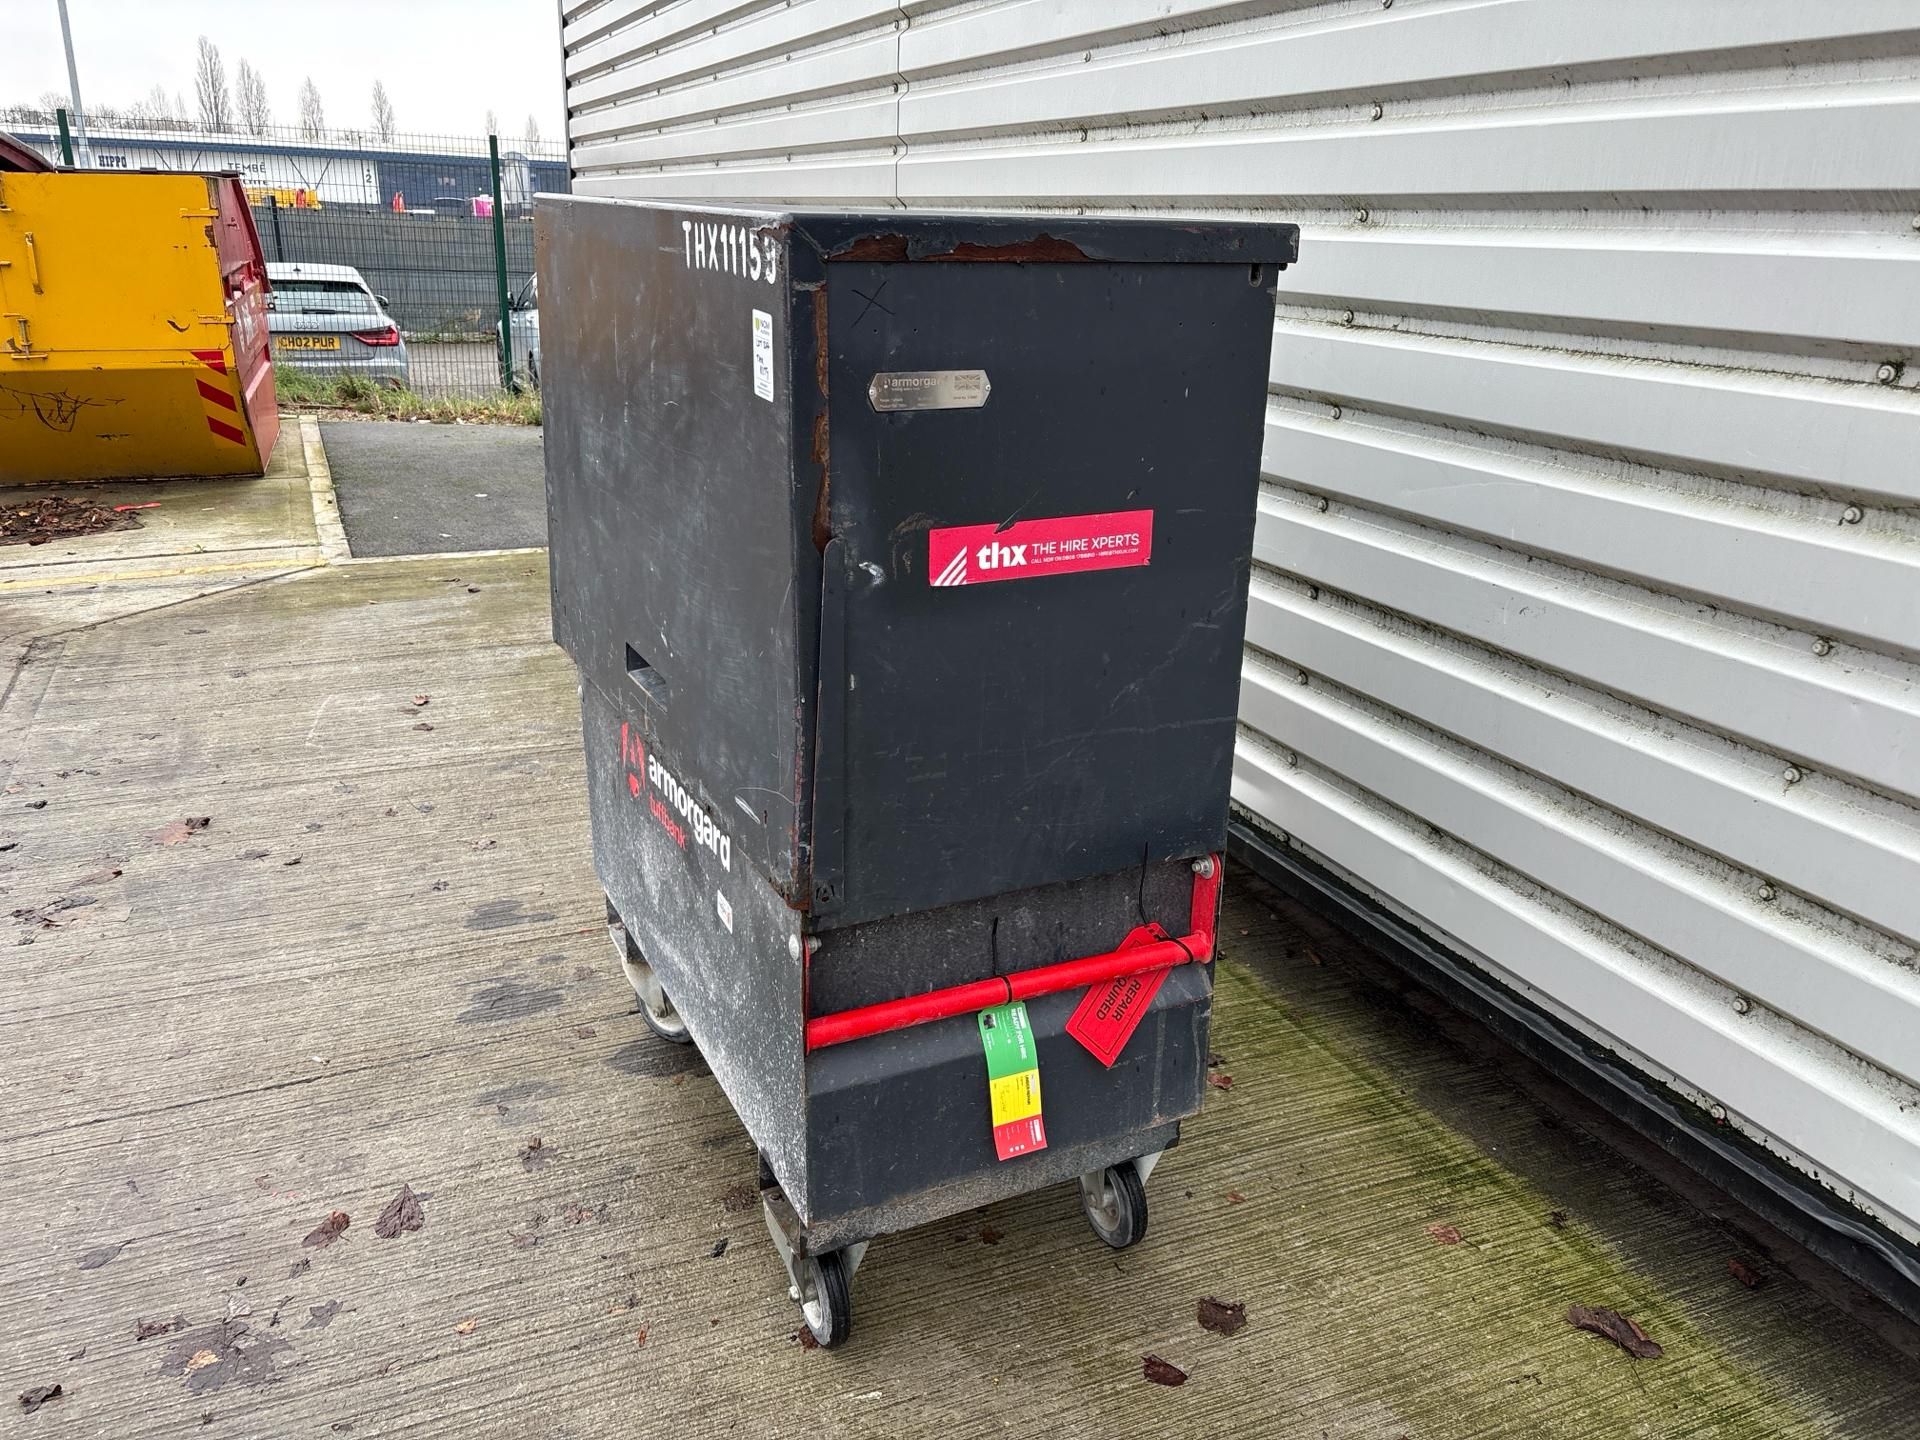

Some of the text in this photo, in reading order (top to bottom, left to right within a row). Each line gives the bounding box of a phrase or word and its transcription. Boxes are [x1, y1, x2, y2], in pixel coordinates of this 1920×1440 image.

[98, 155, 127, 168] HIPPO
[312, 337, 335, 348] PUR
[976, 541, 1028, 570] thx
[1031, 542, 1057, 556] THE
[1060, 538, 1089, 553] HIRE
[1091, 532, 1140, 550] XPERTS
[648, 753, 731, 873] armorgard
[1096, 975, 1130, 1021] QUIRED
[1111, 979, 1142, 1022] REPAIR
